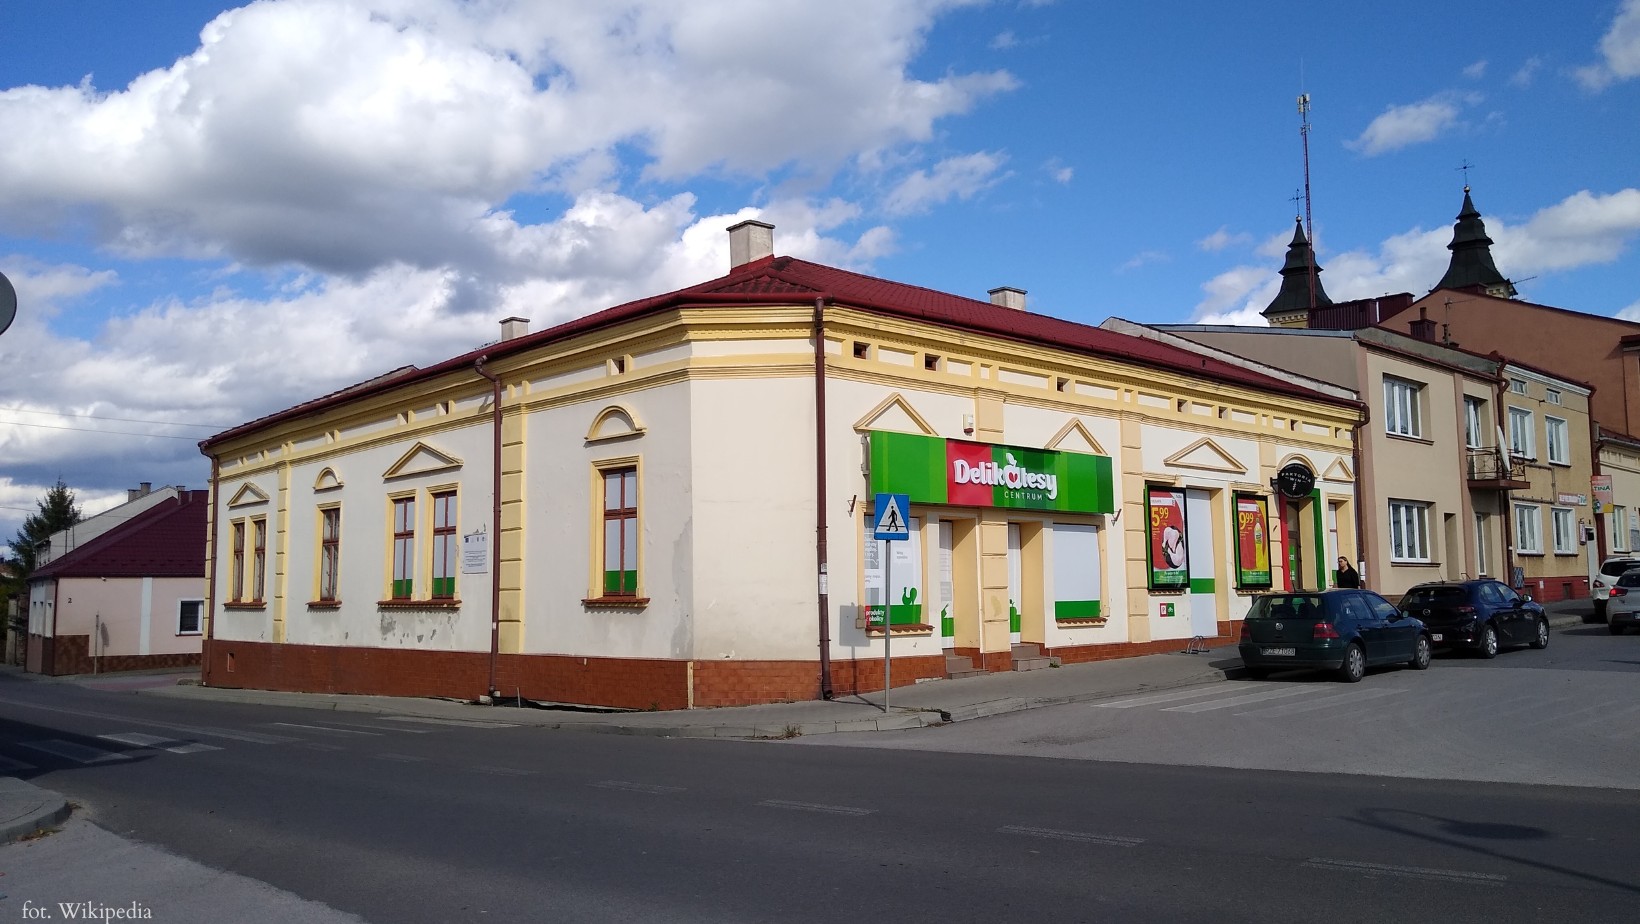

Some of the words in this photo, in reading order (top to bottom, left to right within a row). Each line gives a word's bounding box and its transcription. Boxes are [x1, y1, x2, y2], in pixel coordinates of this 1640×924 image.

[953, 457, 1057, 499] Delikatesy
[1004, 491, 1043, 500] CENTRUM
[866, 609, 885, 617] produkty
